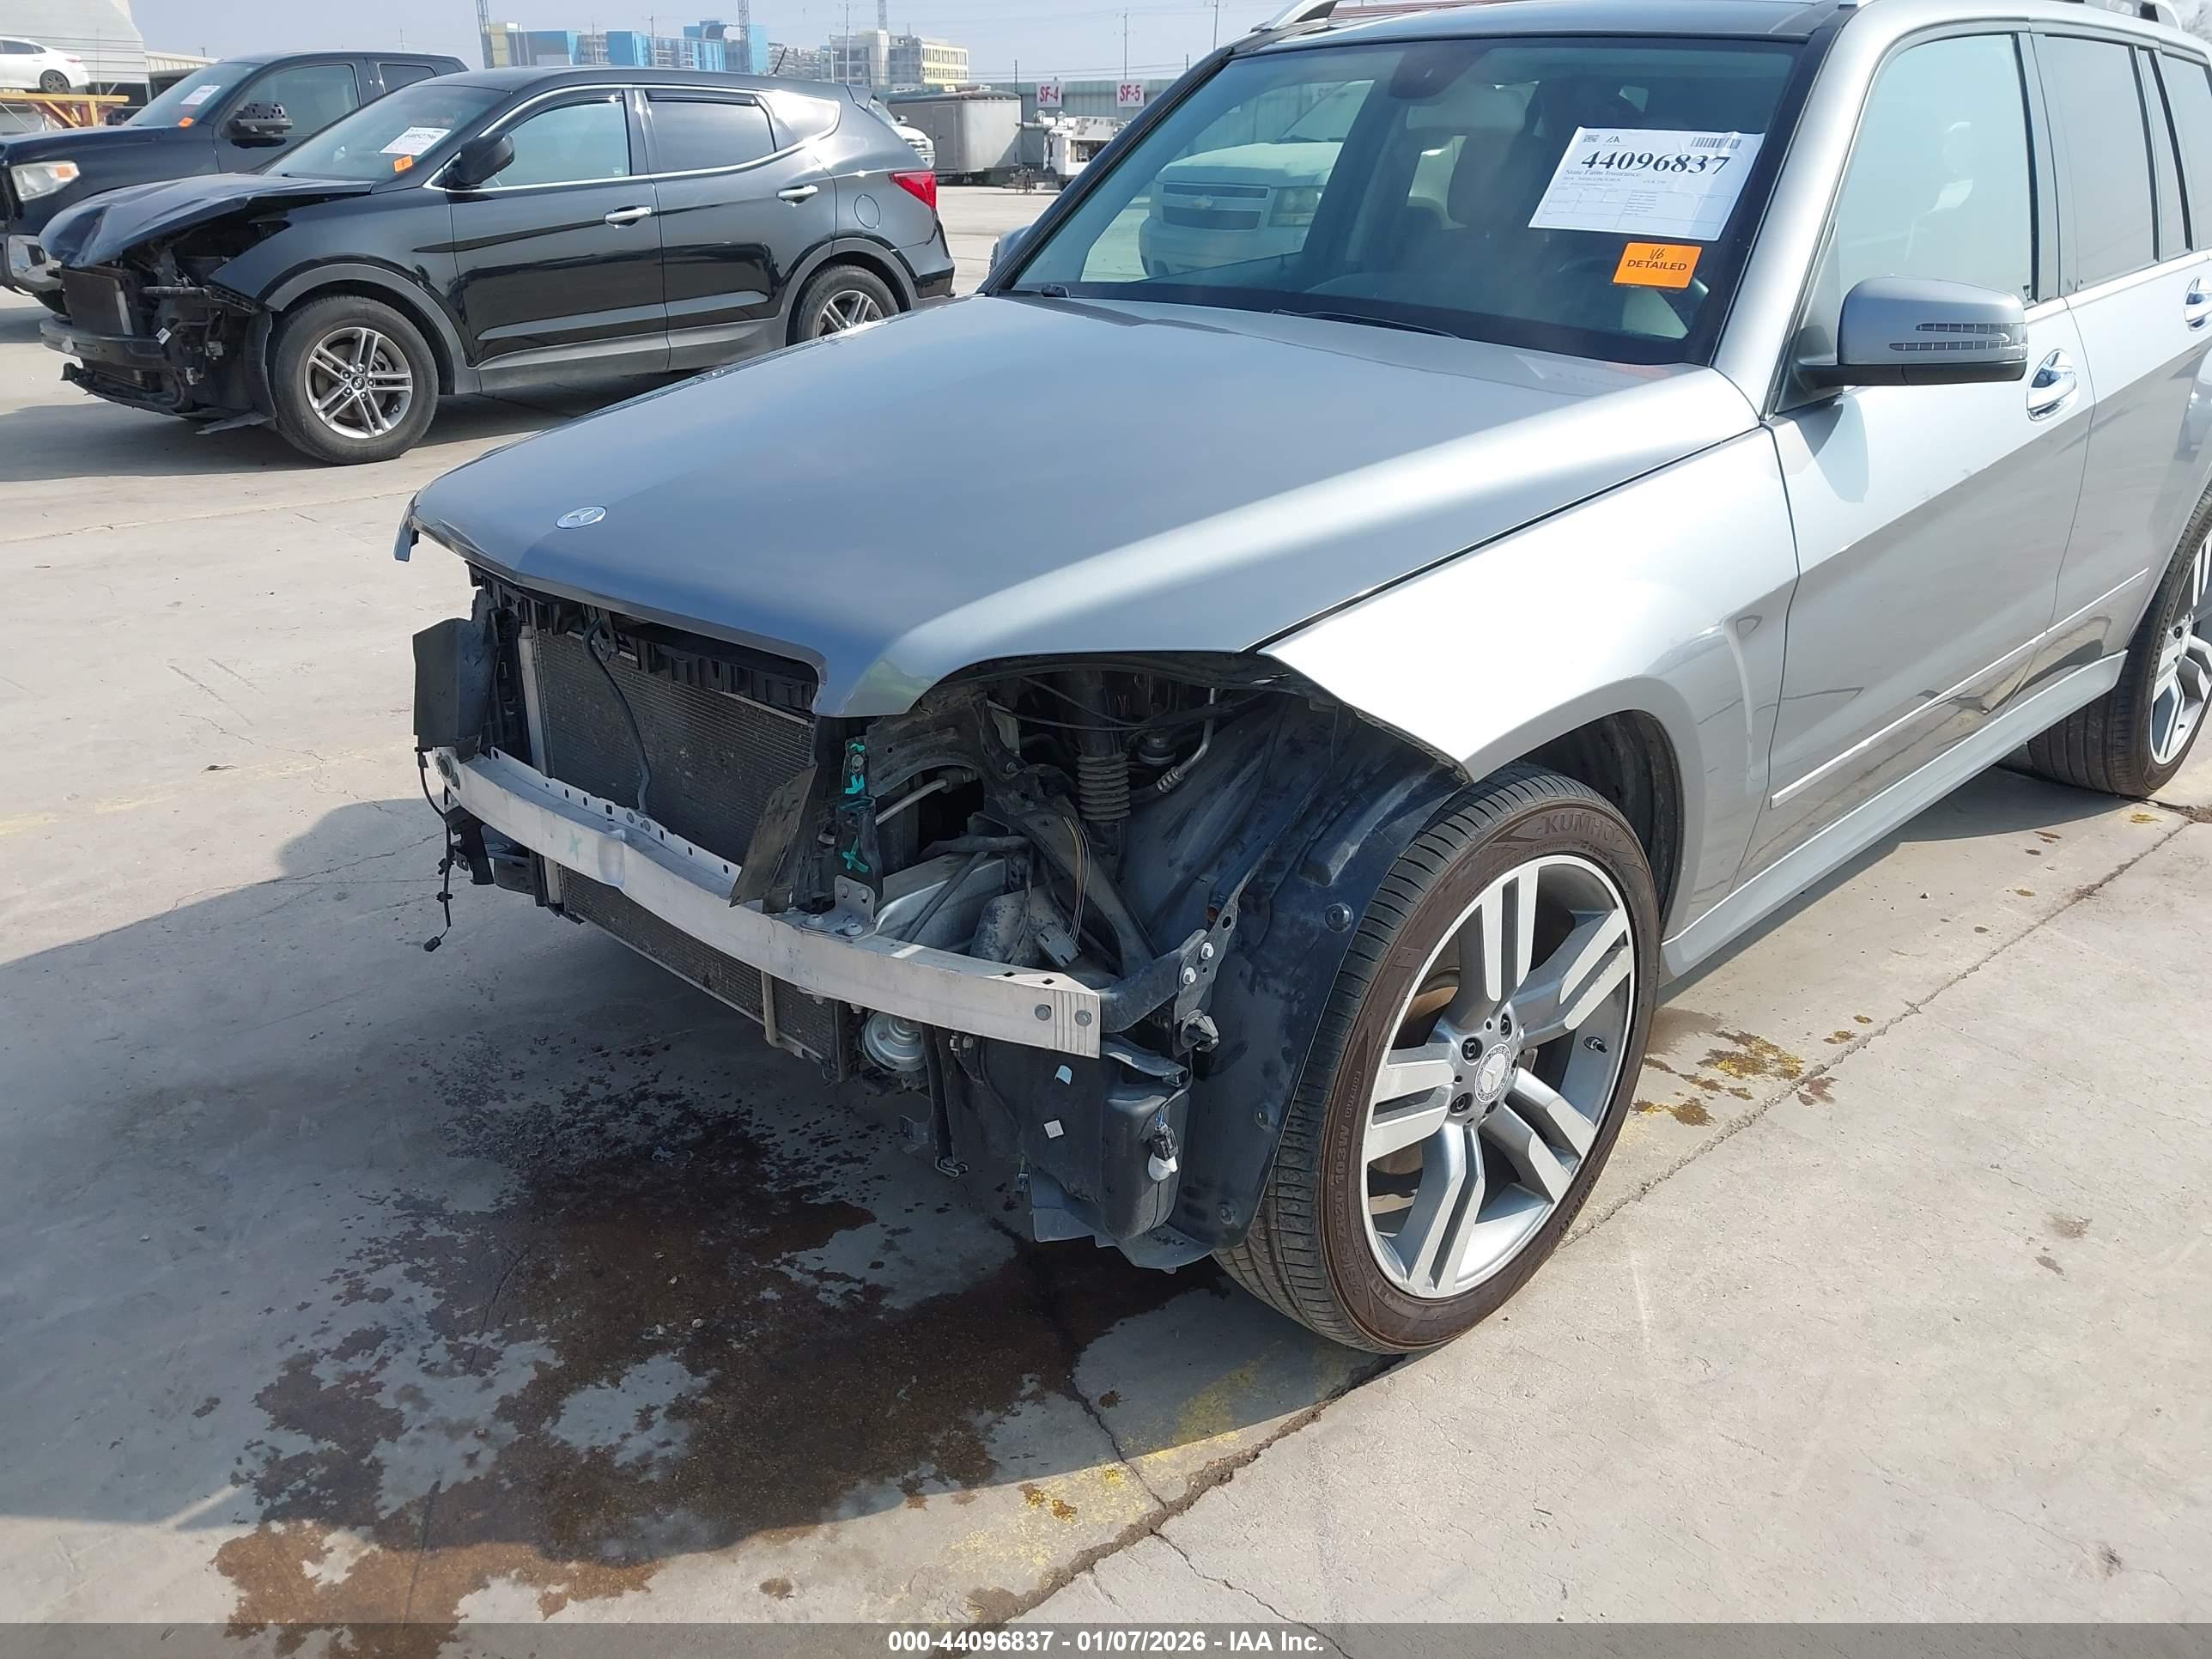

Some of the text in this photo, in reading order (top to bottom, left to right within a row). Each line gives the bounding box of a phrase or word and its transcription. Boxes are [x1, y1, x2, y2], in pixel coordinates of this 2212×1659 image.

[1038, 86, 1059, 102] SF-4
[1119, 84, 1141, 101] SF-5
[1581, 150, 1732, 175] 44096837
[1626, 259, 1687, 271] DETAILED
